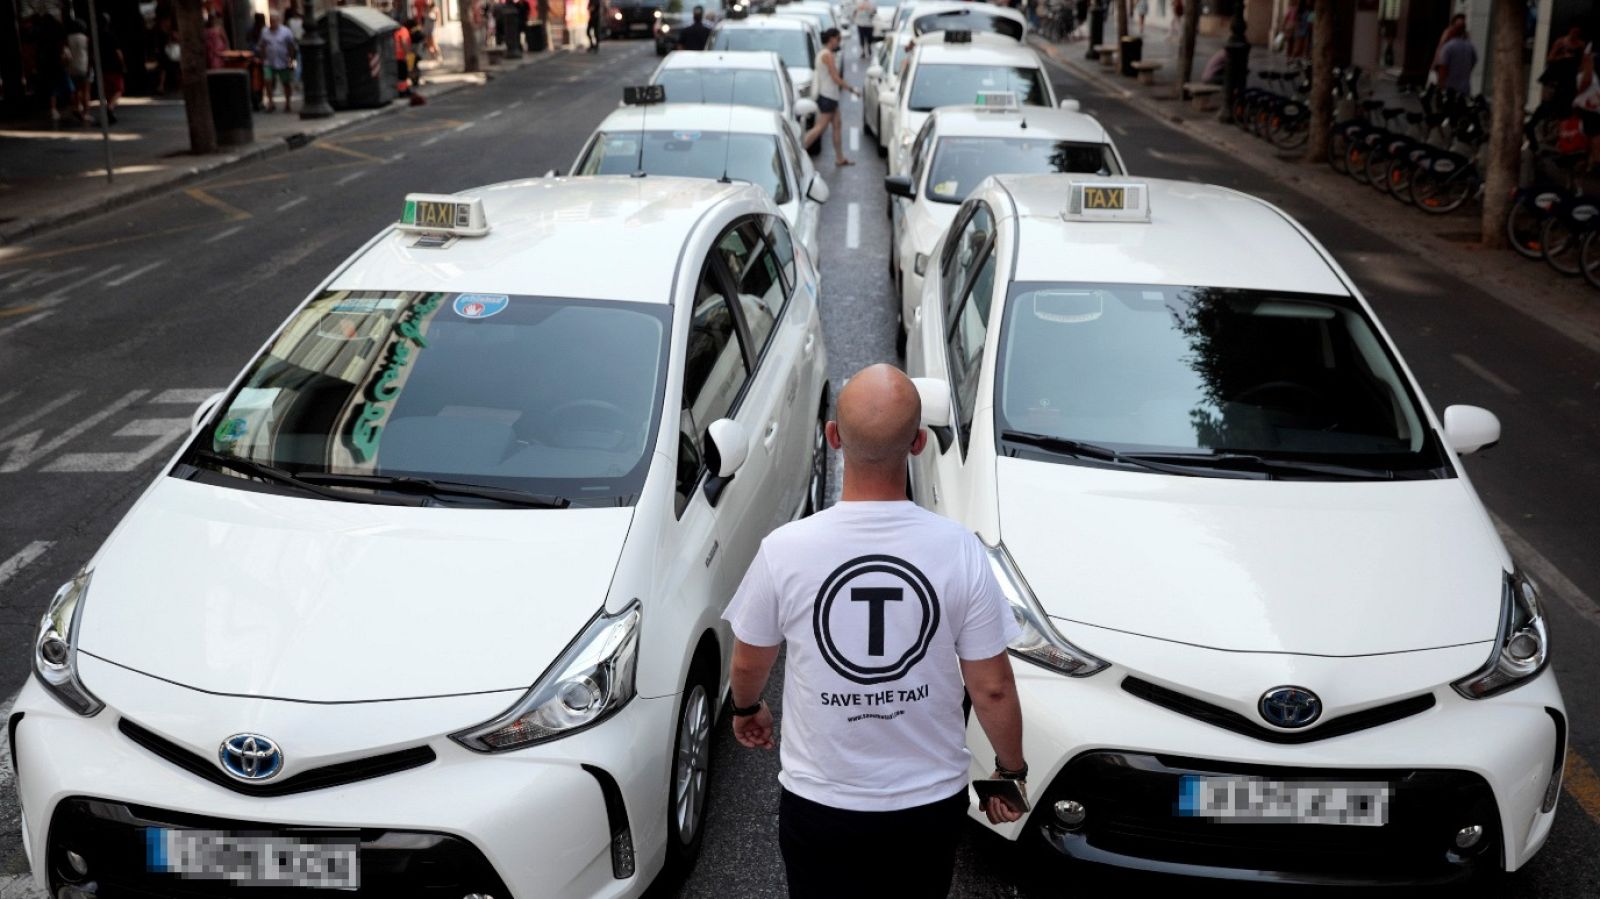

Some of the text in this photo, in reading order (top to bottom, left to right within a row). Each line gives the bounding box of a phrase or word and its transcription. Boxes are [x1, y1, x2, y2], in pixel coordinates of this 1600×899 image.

[1086, 188, 1123, 208] TAXI
[419, 203, 453, 225] TAXI
[850, 587, 904, 656] T
[820, 684, 929, 706] SAVE THE TAXI
